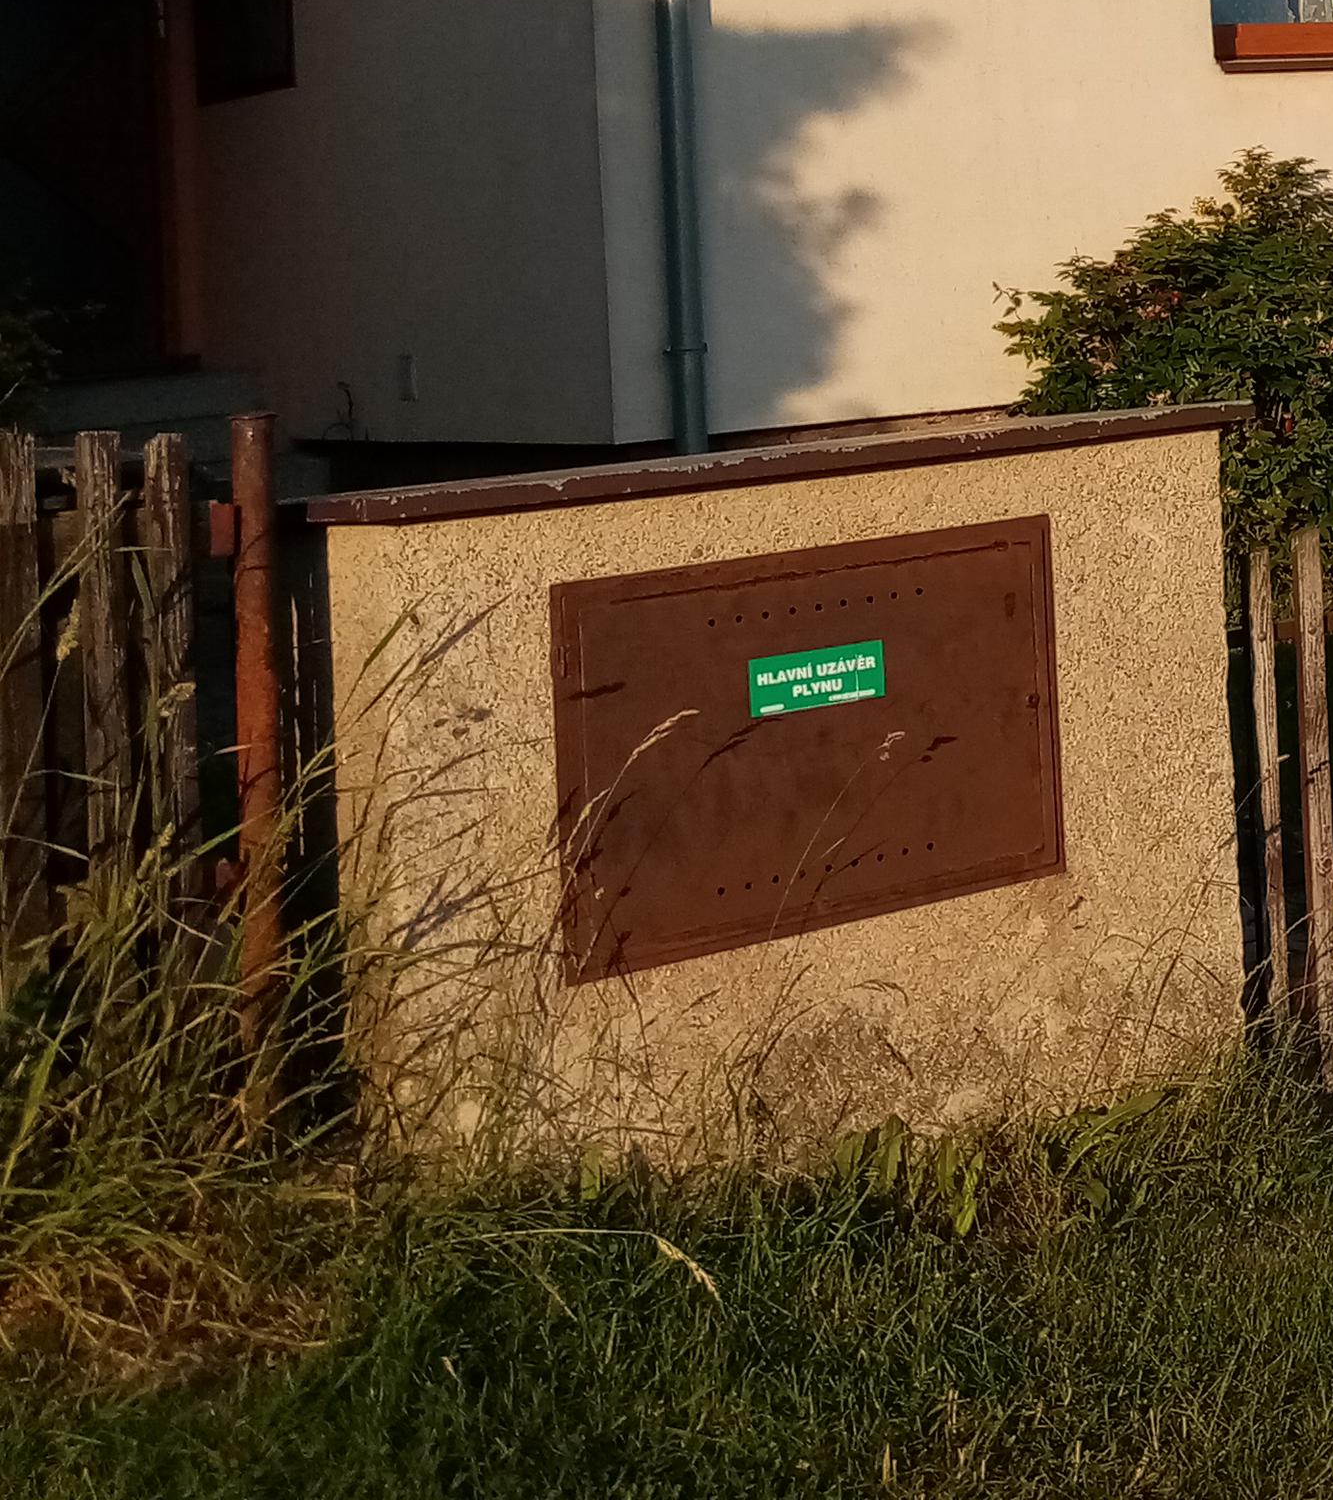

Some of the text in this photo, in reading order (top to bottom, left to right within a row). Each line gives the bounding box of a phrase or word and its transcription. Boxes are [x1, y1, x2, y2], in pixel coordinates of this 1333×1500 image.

[756, 654, 876, 686] HLAVNÍ UZÁVĚR
[792, 678, 843, 697] PLYNU
